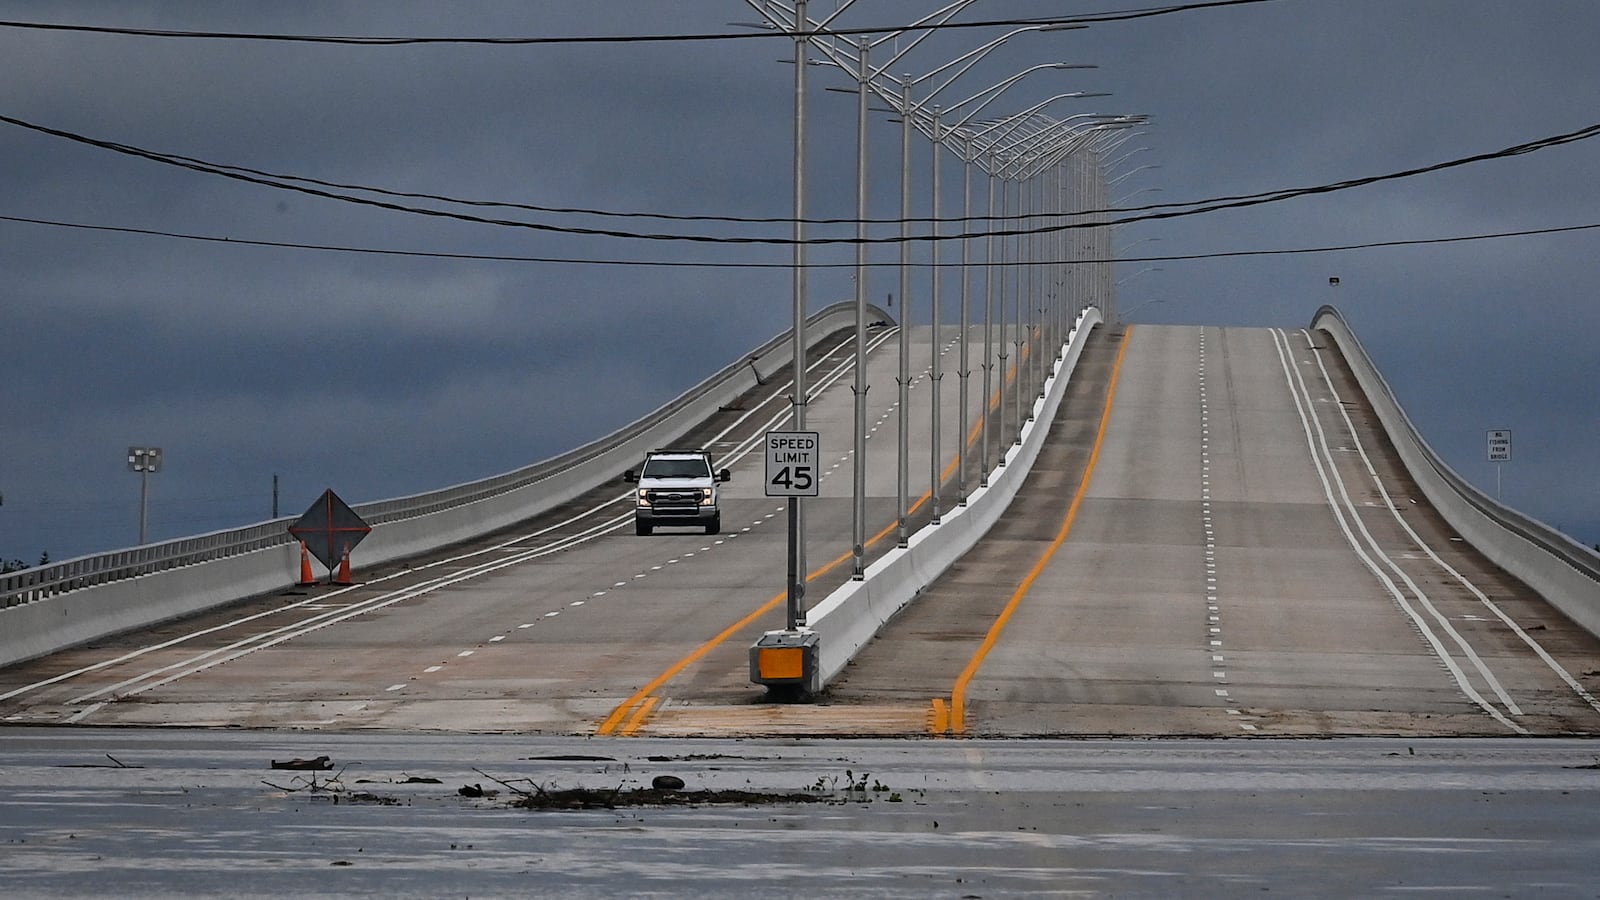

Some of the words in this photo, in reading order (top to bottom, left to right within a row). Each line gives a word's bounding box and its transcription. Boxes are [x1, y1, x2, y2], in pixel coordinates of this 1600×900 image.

[771, 439, 814, 449] SPEED
[775, 452, 809, 463] LIMIT
[771, 466, 812, 490] 45
